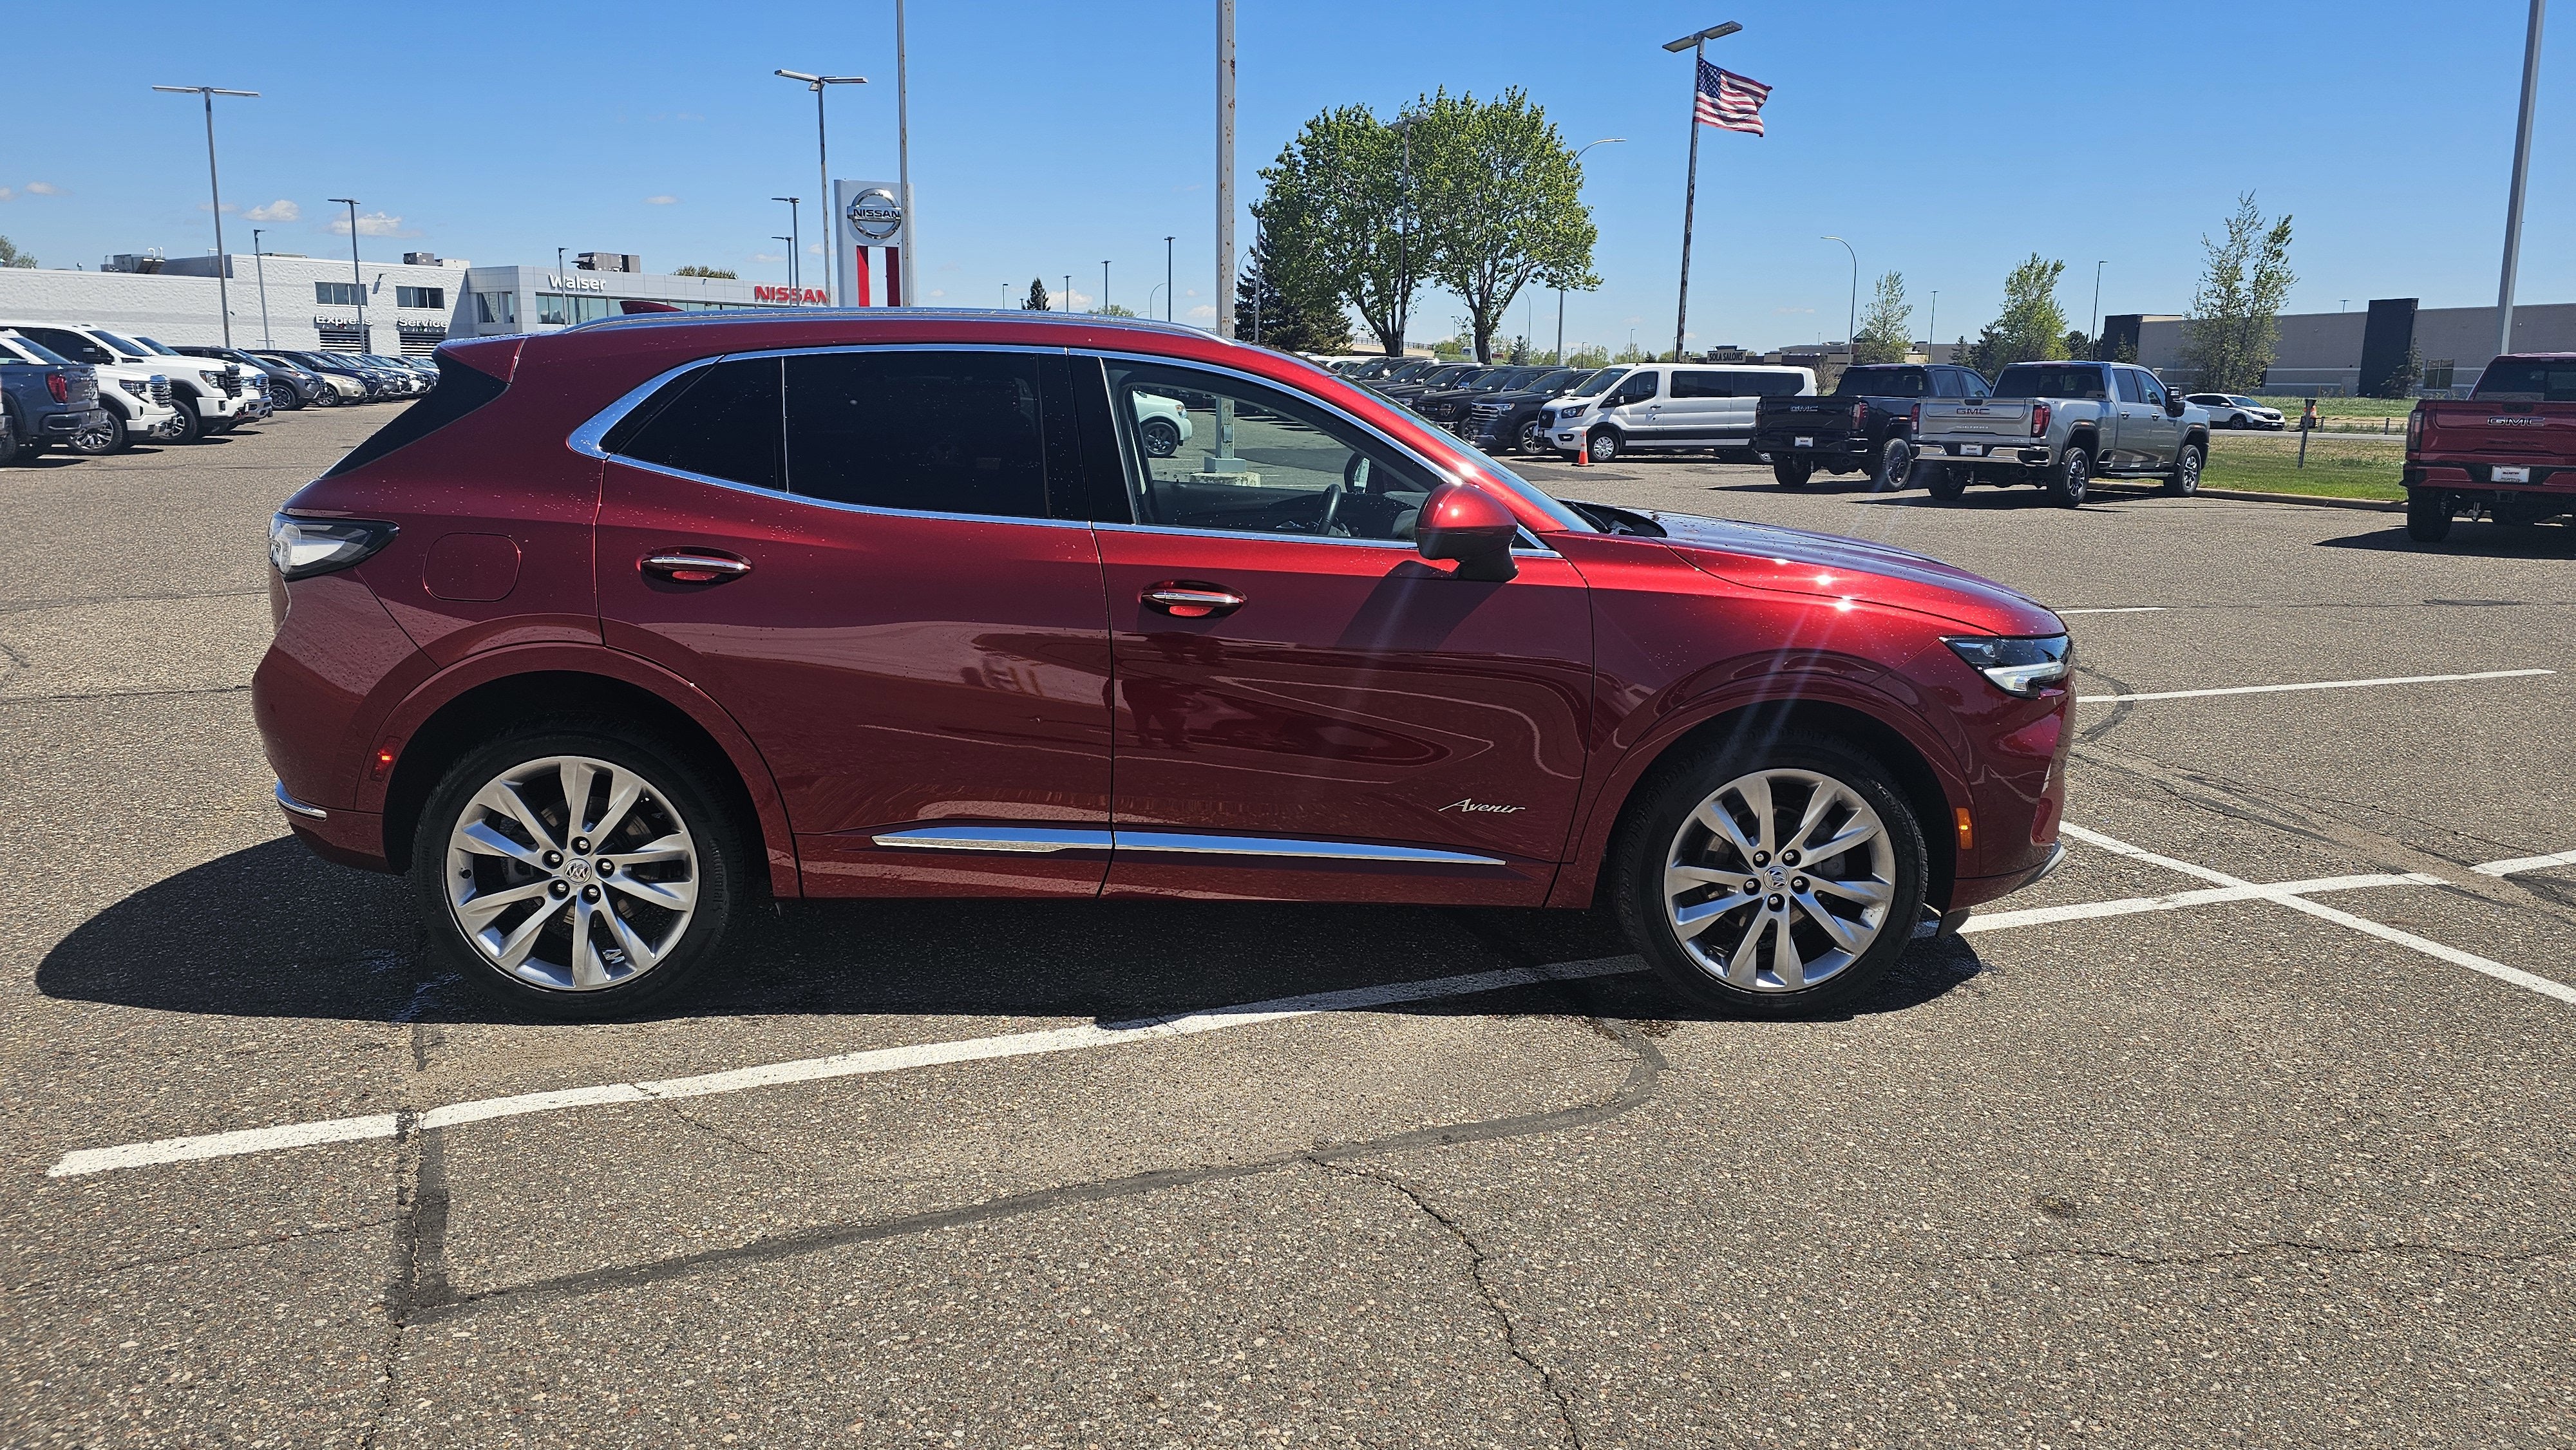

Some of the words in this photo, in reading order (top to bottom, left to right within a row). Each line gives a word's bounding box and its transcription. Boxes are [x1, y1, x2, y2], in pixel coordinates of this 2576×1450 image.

[853, 209, 900, 218] NISSAN
[548, 274, 607, 291] Walser
[754, 285, 828, 304] NISSAN
[398, 318, 448, 327] Service
[1709, 353, 1722, 361] SOLA
[1723, 352, 1743, 361] SALONS
[2487, 417, 2545, 426] GMC
[1438, 798, 1526, 813] Avenir
